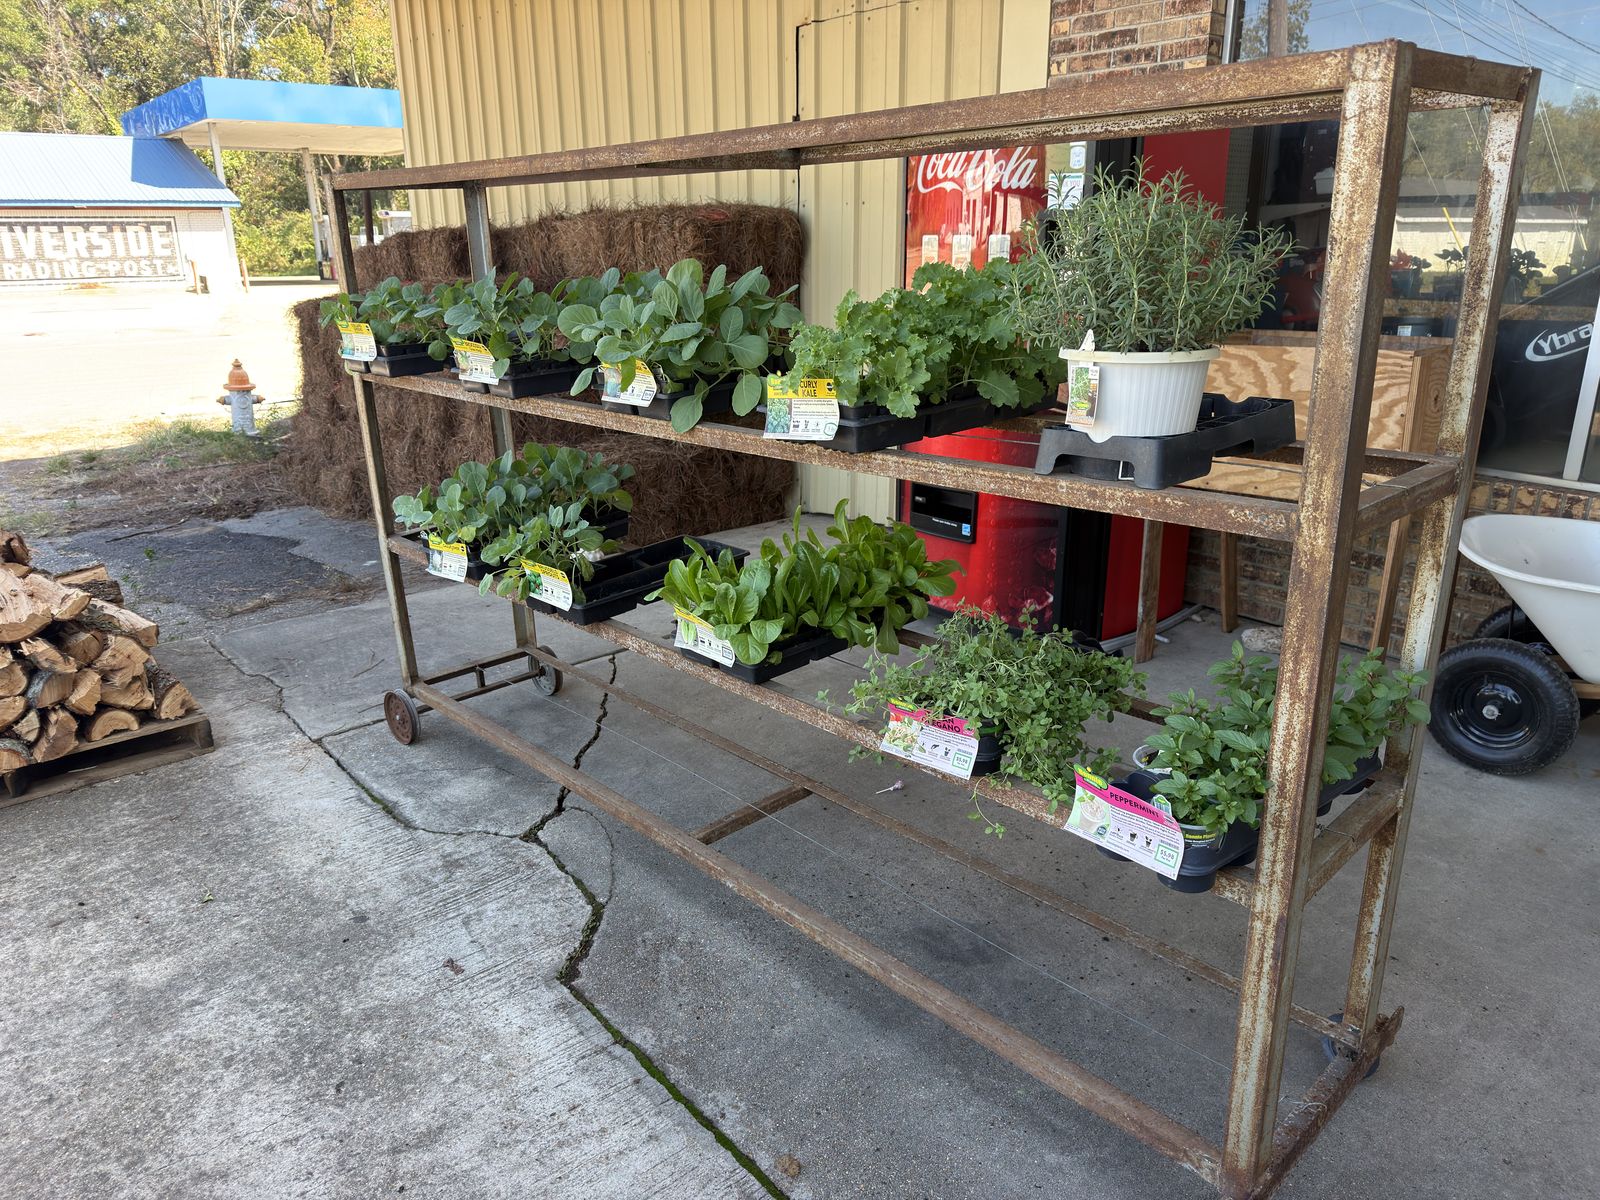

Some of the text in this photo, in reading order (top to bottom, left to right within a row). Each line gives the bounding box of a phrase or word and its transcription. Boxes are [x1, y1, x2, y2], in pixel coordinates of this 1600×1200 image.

[917, 146, 1038, 193] Coca-Cola
[0, 225, 174, 259] IVERSIDE
[1537, 322, 1594, 355] Ybra
[800, 380, 818, 389] CURLY
[802, 389, 818, 397] KALE
[922, 717, 961, 733] EGANO
[1109, 791, 1159, 818] PEPPERMINT
[1160, 849, 1175, 861] $5.98
